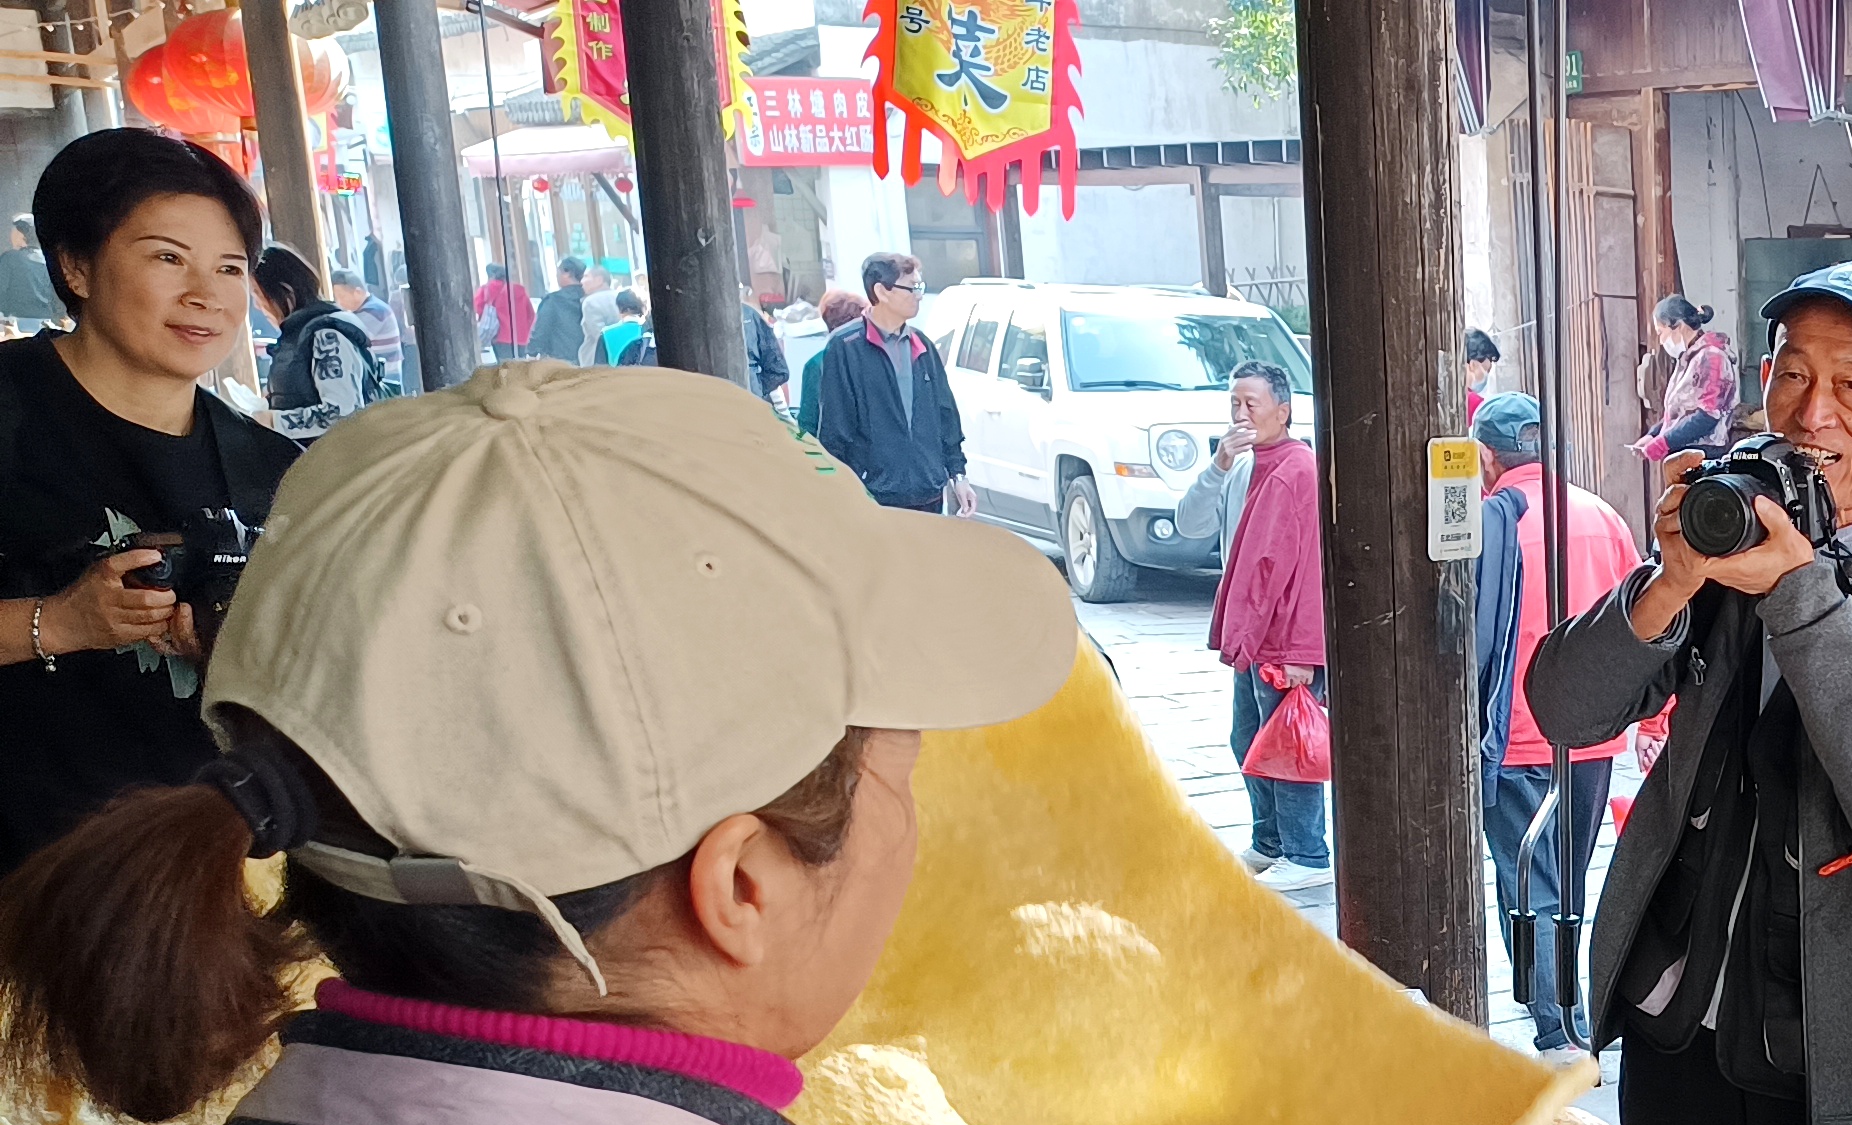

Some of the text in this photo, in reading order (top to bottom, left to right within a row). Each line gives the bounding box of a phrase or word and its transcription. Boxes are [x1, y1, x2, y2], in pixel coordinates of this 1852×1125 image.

[899, 6, 930, 34] 号
[584, 0, 613, 60] 制作
[1732, 451, 1759, 461] Nikon
[213, 553, 248, 564] Nikon
